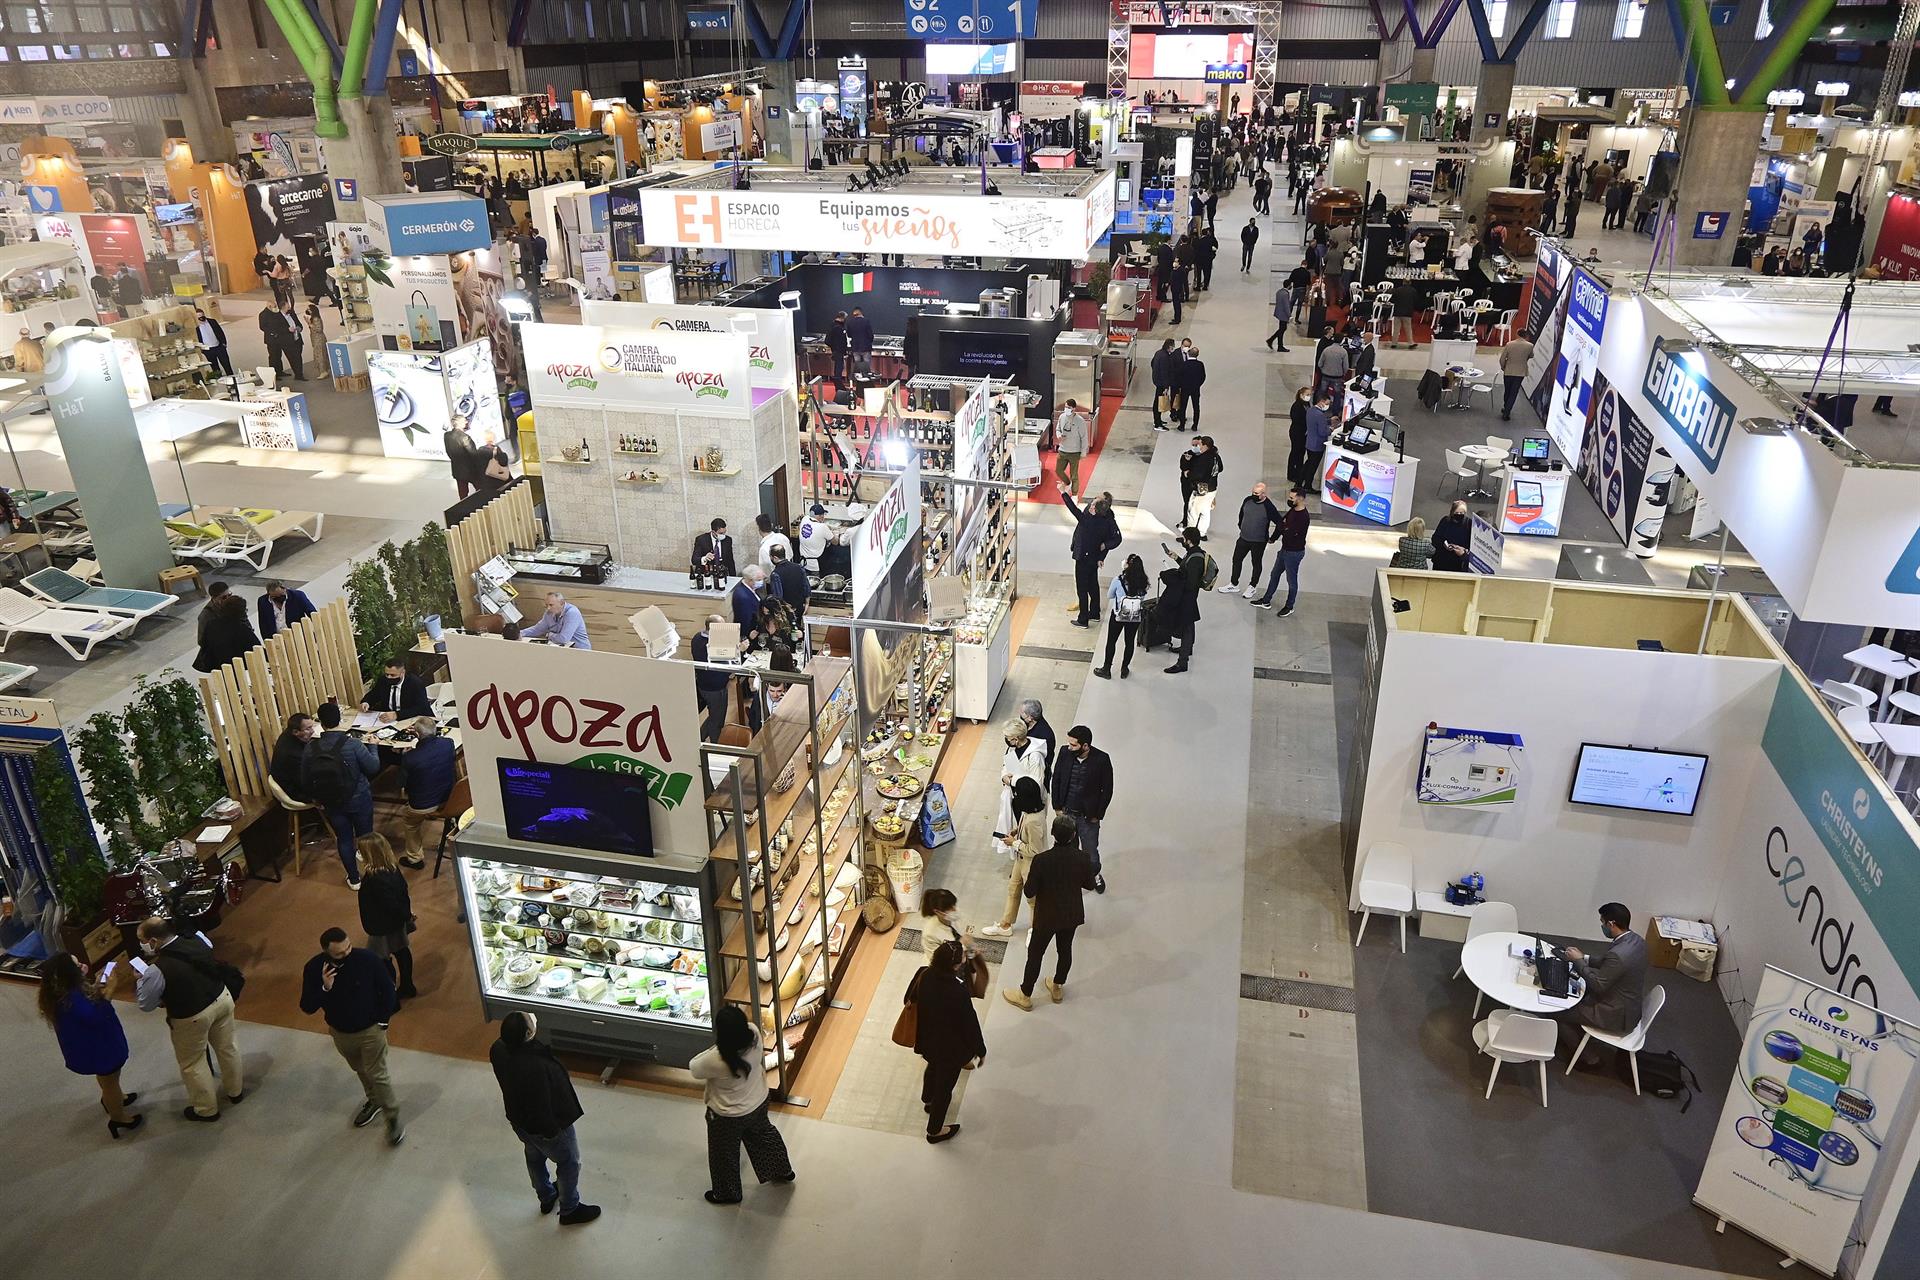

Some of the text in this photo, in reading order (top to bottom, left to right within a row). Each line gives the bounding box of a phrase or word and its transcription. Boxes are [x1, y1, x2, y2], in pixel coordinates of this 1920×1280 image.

[1723, 11, 1731, 24] 1
[1207, 69, 1244, 80] makro
[61, 102, 109, 116] EL COPO
[279, 187, 323, 205] arcecarne
[727, 202, 780, 216] ESPACIO
[819, 200, 910, 217] Equipamos
[401, 219, 458, 236] CERMERÓN
[728, 216, 781, 232] HORECA
[842, 206, 961, 249] tus sueños
[400, 270, 447, 278] PERSONALIZAMOS
[1887, 259, 1904, 274] KLIC
[675, 319, 710, 331] CAMERA
[622, 344, 660, 355] CAMERA
[623, 353, 677, 366] COMMERCIO
[623, 362, 664, 373] ITALIANA
[547, 362, 594, 383] apoza
[676, 370, 723, 391] apoza
[58, 396, 84, 419] H&T
[1647, 347, 1729, 460] GIRBAU
[870, 478, 906, 556] apoza
[0, 706, 28, 718] ETAL
[467, 682, 673, 763] apoza
[1821, 789, 1884, 888] CHRISTEYNS
[1841, 842, 1873, 896] TECHNOLOGY
[1788, 1007, 1880, 1052] CHRISTEYNS
[1732, 1170, 1767, 1192] PASSIONATE
